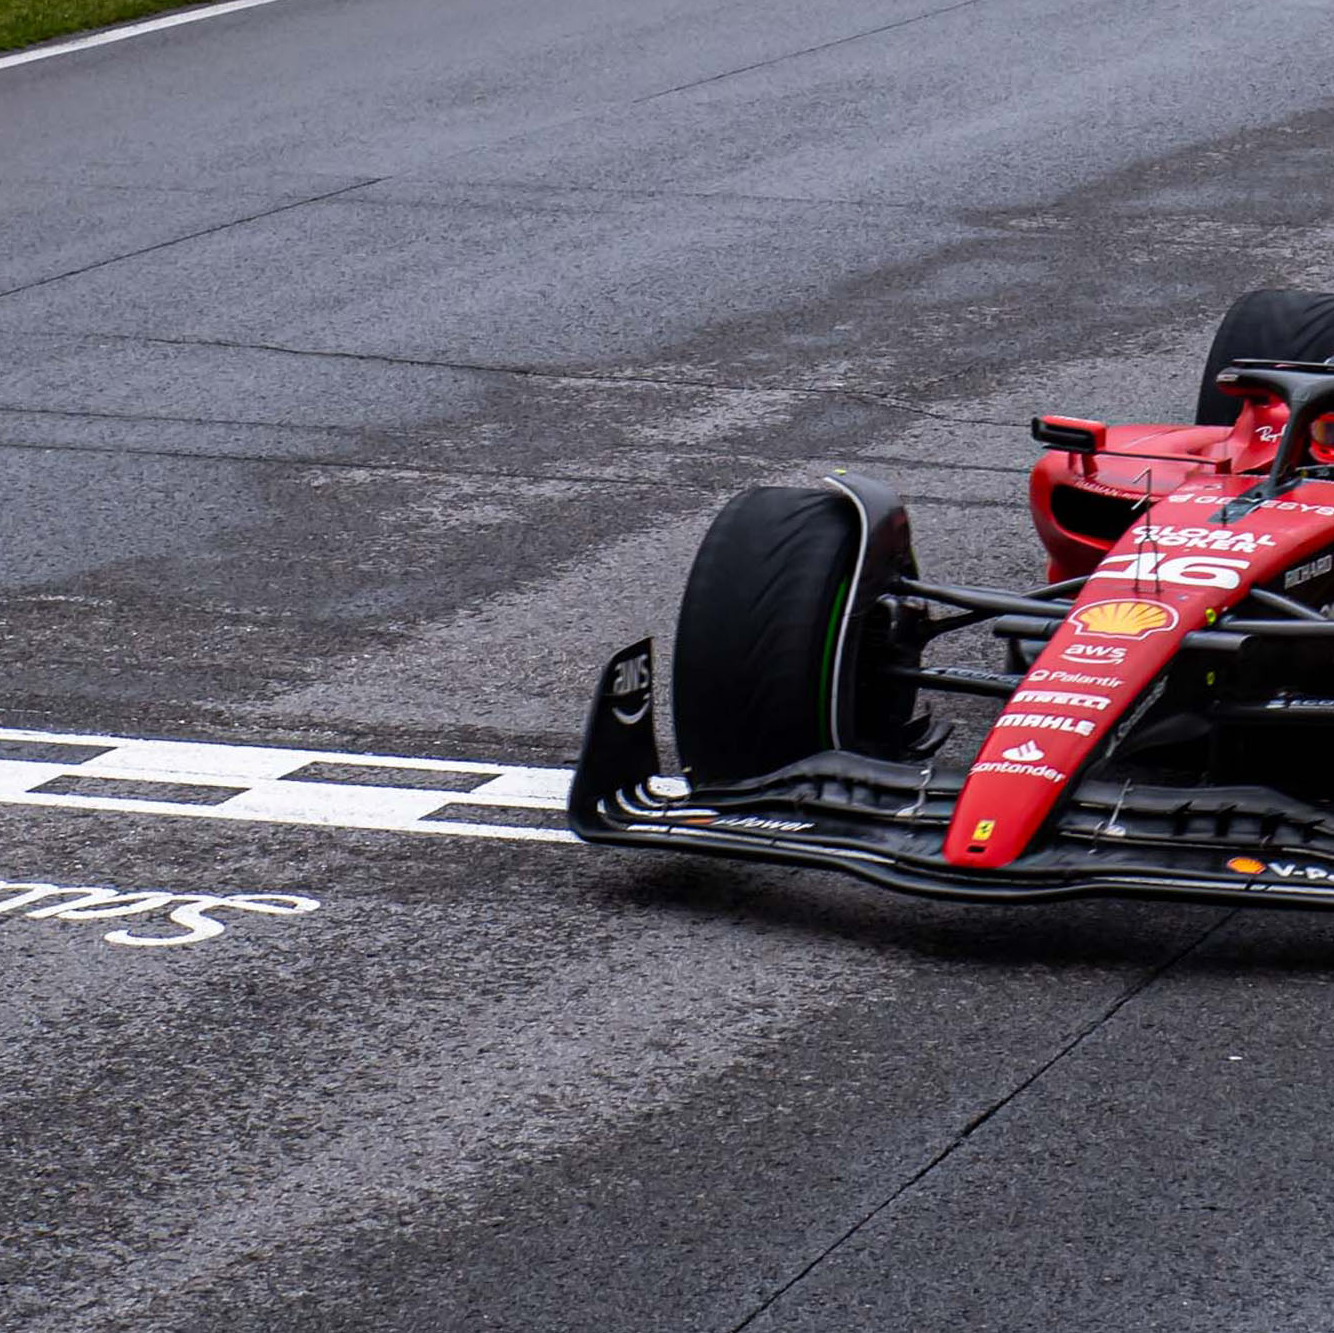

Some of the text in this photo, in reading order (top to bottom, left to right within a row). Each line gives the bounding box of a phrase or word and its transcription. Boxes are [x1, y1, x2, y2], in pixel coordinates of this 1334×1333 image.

[1132, 525, 1277, 547] GLOBAL
[1134, 534, 1258, 553] POKER
[1090, 552, 1251, 590] 16
[1063, 643, 1128, 661] aws
[1049, 670, 1125, 689] Palantir
[1011, 691, 1111, 710] PIRELLI
[995, 714, 1097, 736] MAHLE
